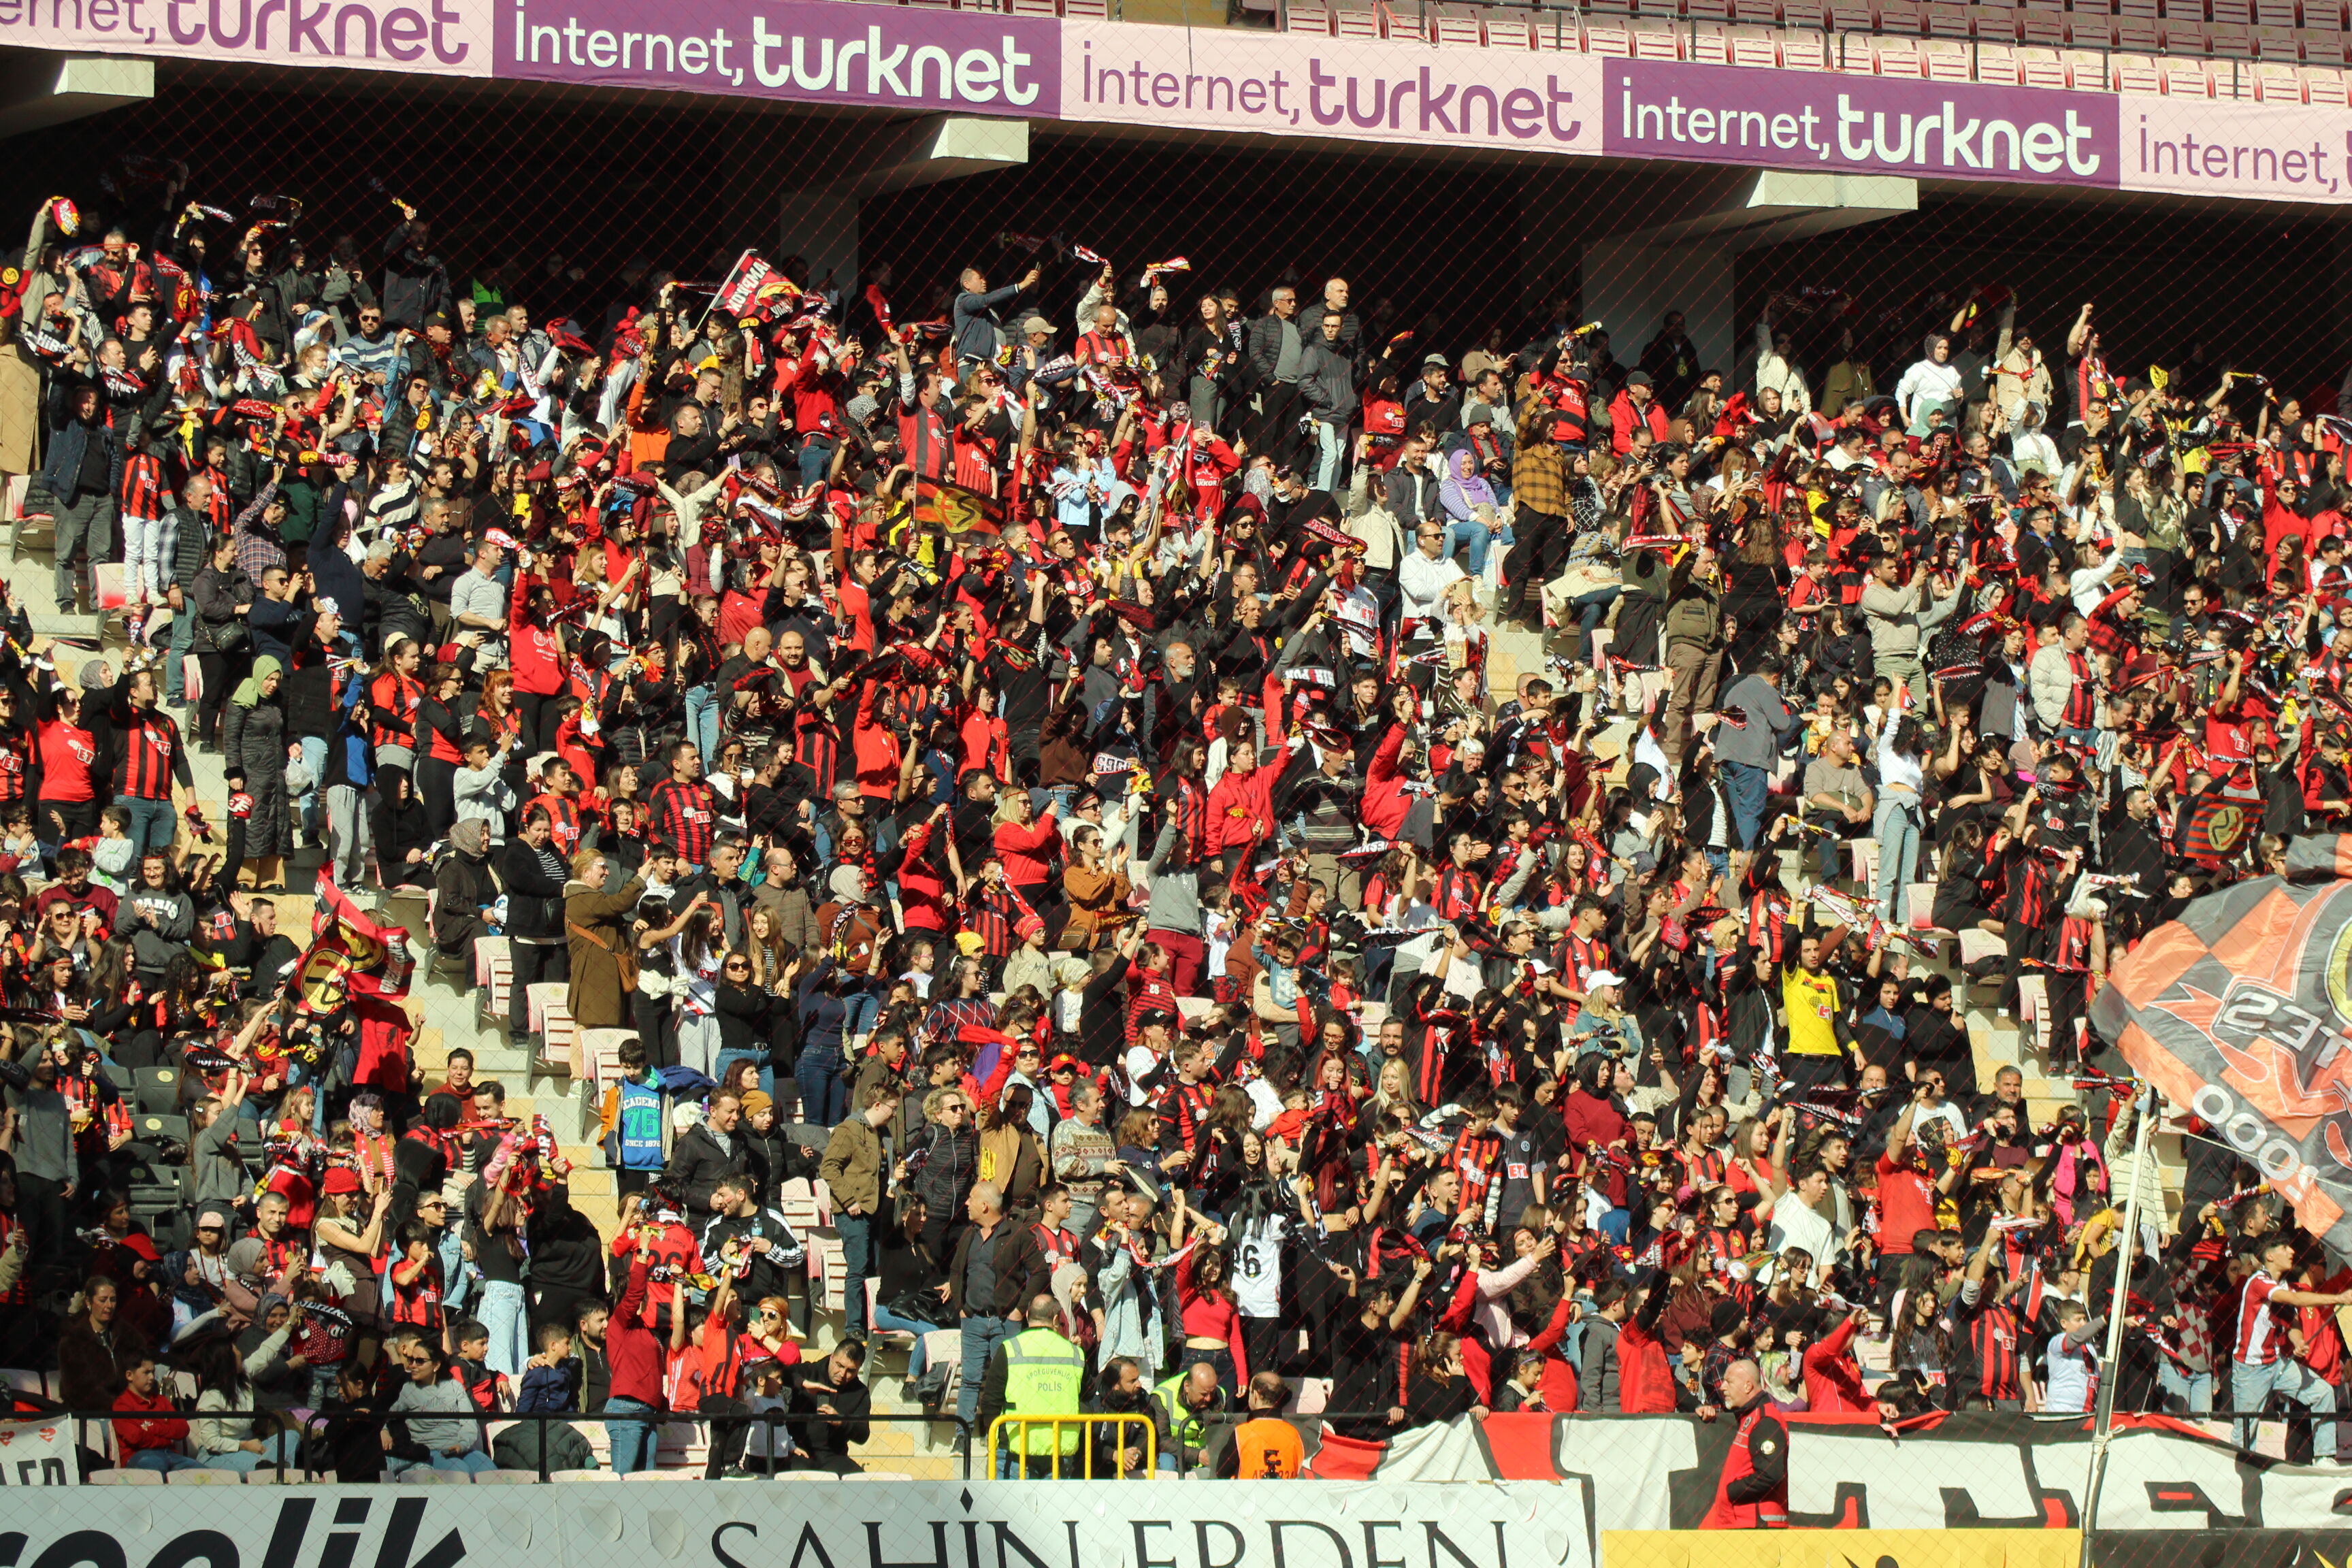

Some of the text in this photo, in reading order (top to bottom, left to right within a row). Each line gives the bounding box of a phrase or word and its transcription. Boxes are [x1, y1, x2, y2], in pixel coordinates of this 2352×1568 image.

[753, 16, 1039, 105] turknet
[1309, 59, 1582, 142] turknet
[1838, 94, 2100, 177] turknet
[693, 811, 710, 823] ETi
[624, 1109, 659, 1138] 76
[1038, 1381, 1062, 1392] POLİS
